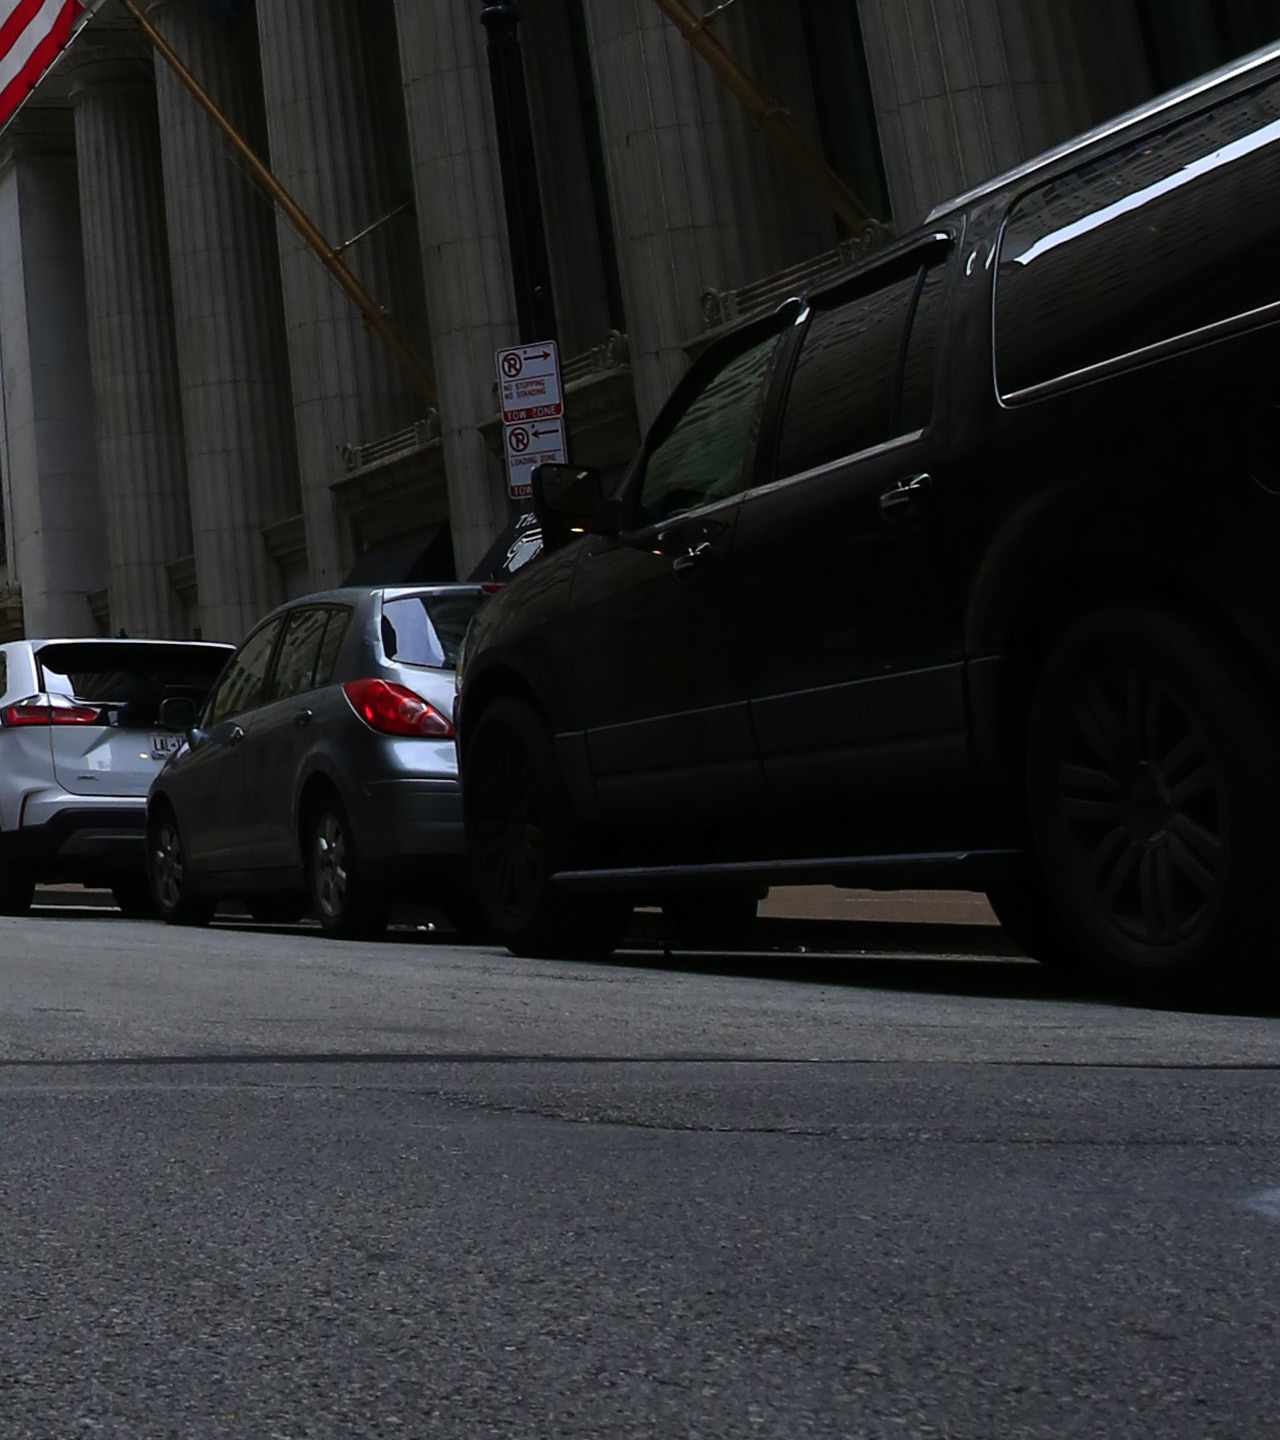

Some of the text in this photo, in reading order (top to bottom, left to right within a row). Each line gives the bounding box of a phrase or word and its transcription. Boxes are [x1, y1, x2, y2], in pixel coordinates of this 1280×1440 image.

[507, 405, 557, 421] TOW ZONE
[511, 456, 537, 466] LOADING
